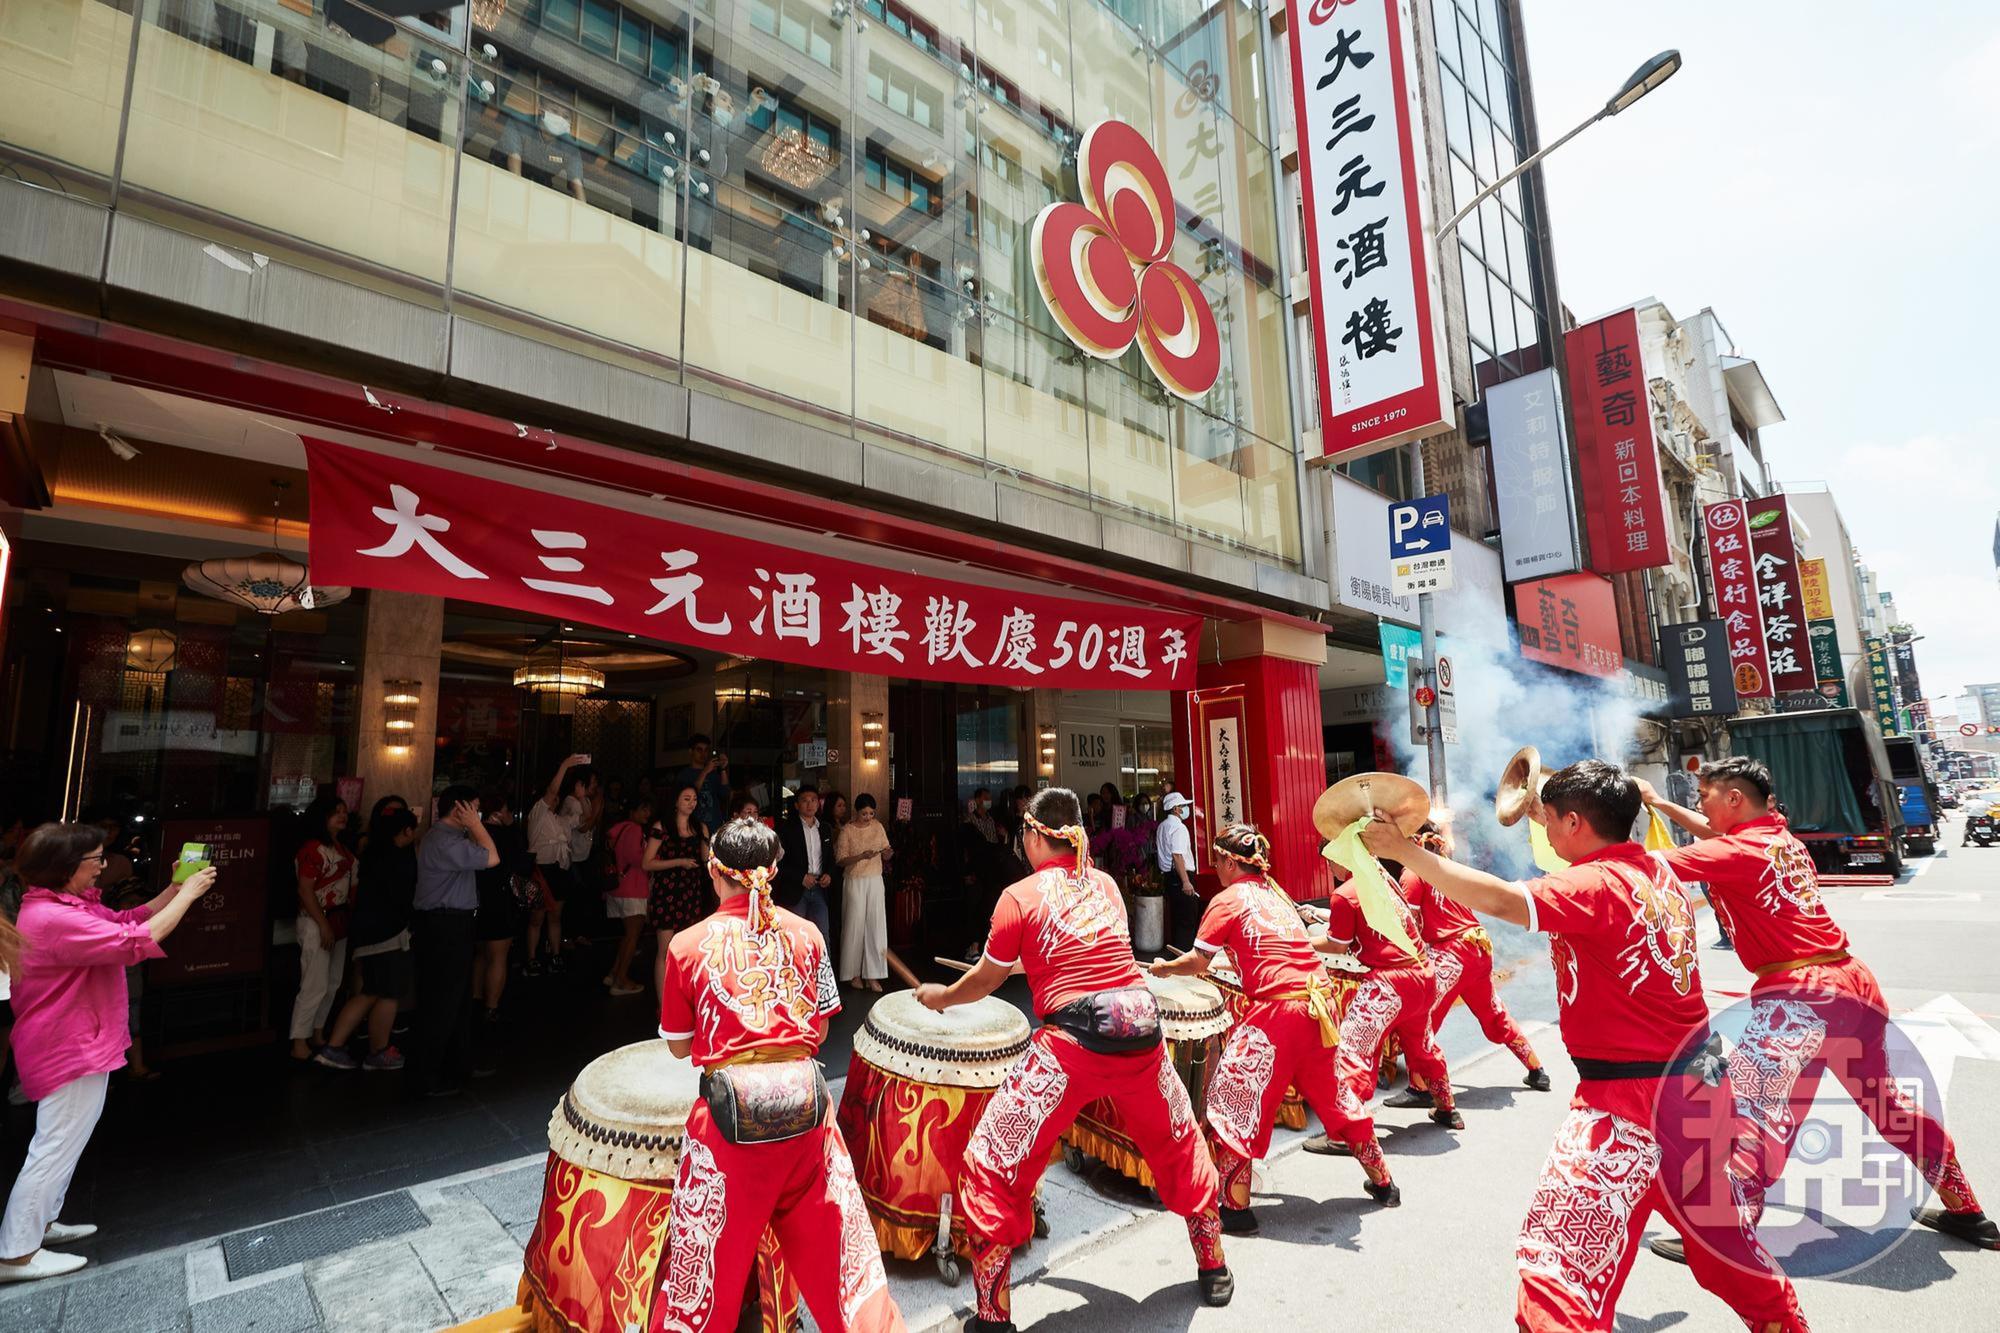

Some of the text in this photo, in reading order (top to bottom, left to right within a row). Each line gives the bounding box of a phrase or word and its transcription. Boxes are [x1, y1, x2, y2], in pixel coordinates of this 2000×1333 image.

[1316, 29, 1404, 360] 大三元酒樓
[1351, 408, 1407, 433] SINCE 1970
[1596, 322, 1637, 427] 藝奇
[1393, 506, 1418, 544] P
[356, 484, 1188, 681] 大三元酒樓歡慶50週年
[1714, 533, 1758, 658] 伍宗行食品
[1755, 552, 1803, 675] 全祥茶莊
[1684, 646, 1713, 712] 嘟嘟精品
[1070, 733, 1106, 758] IRIS
